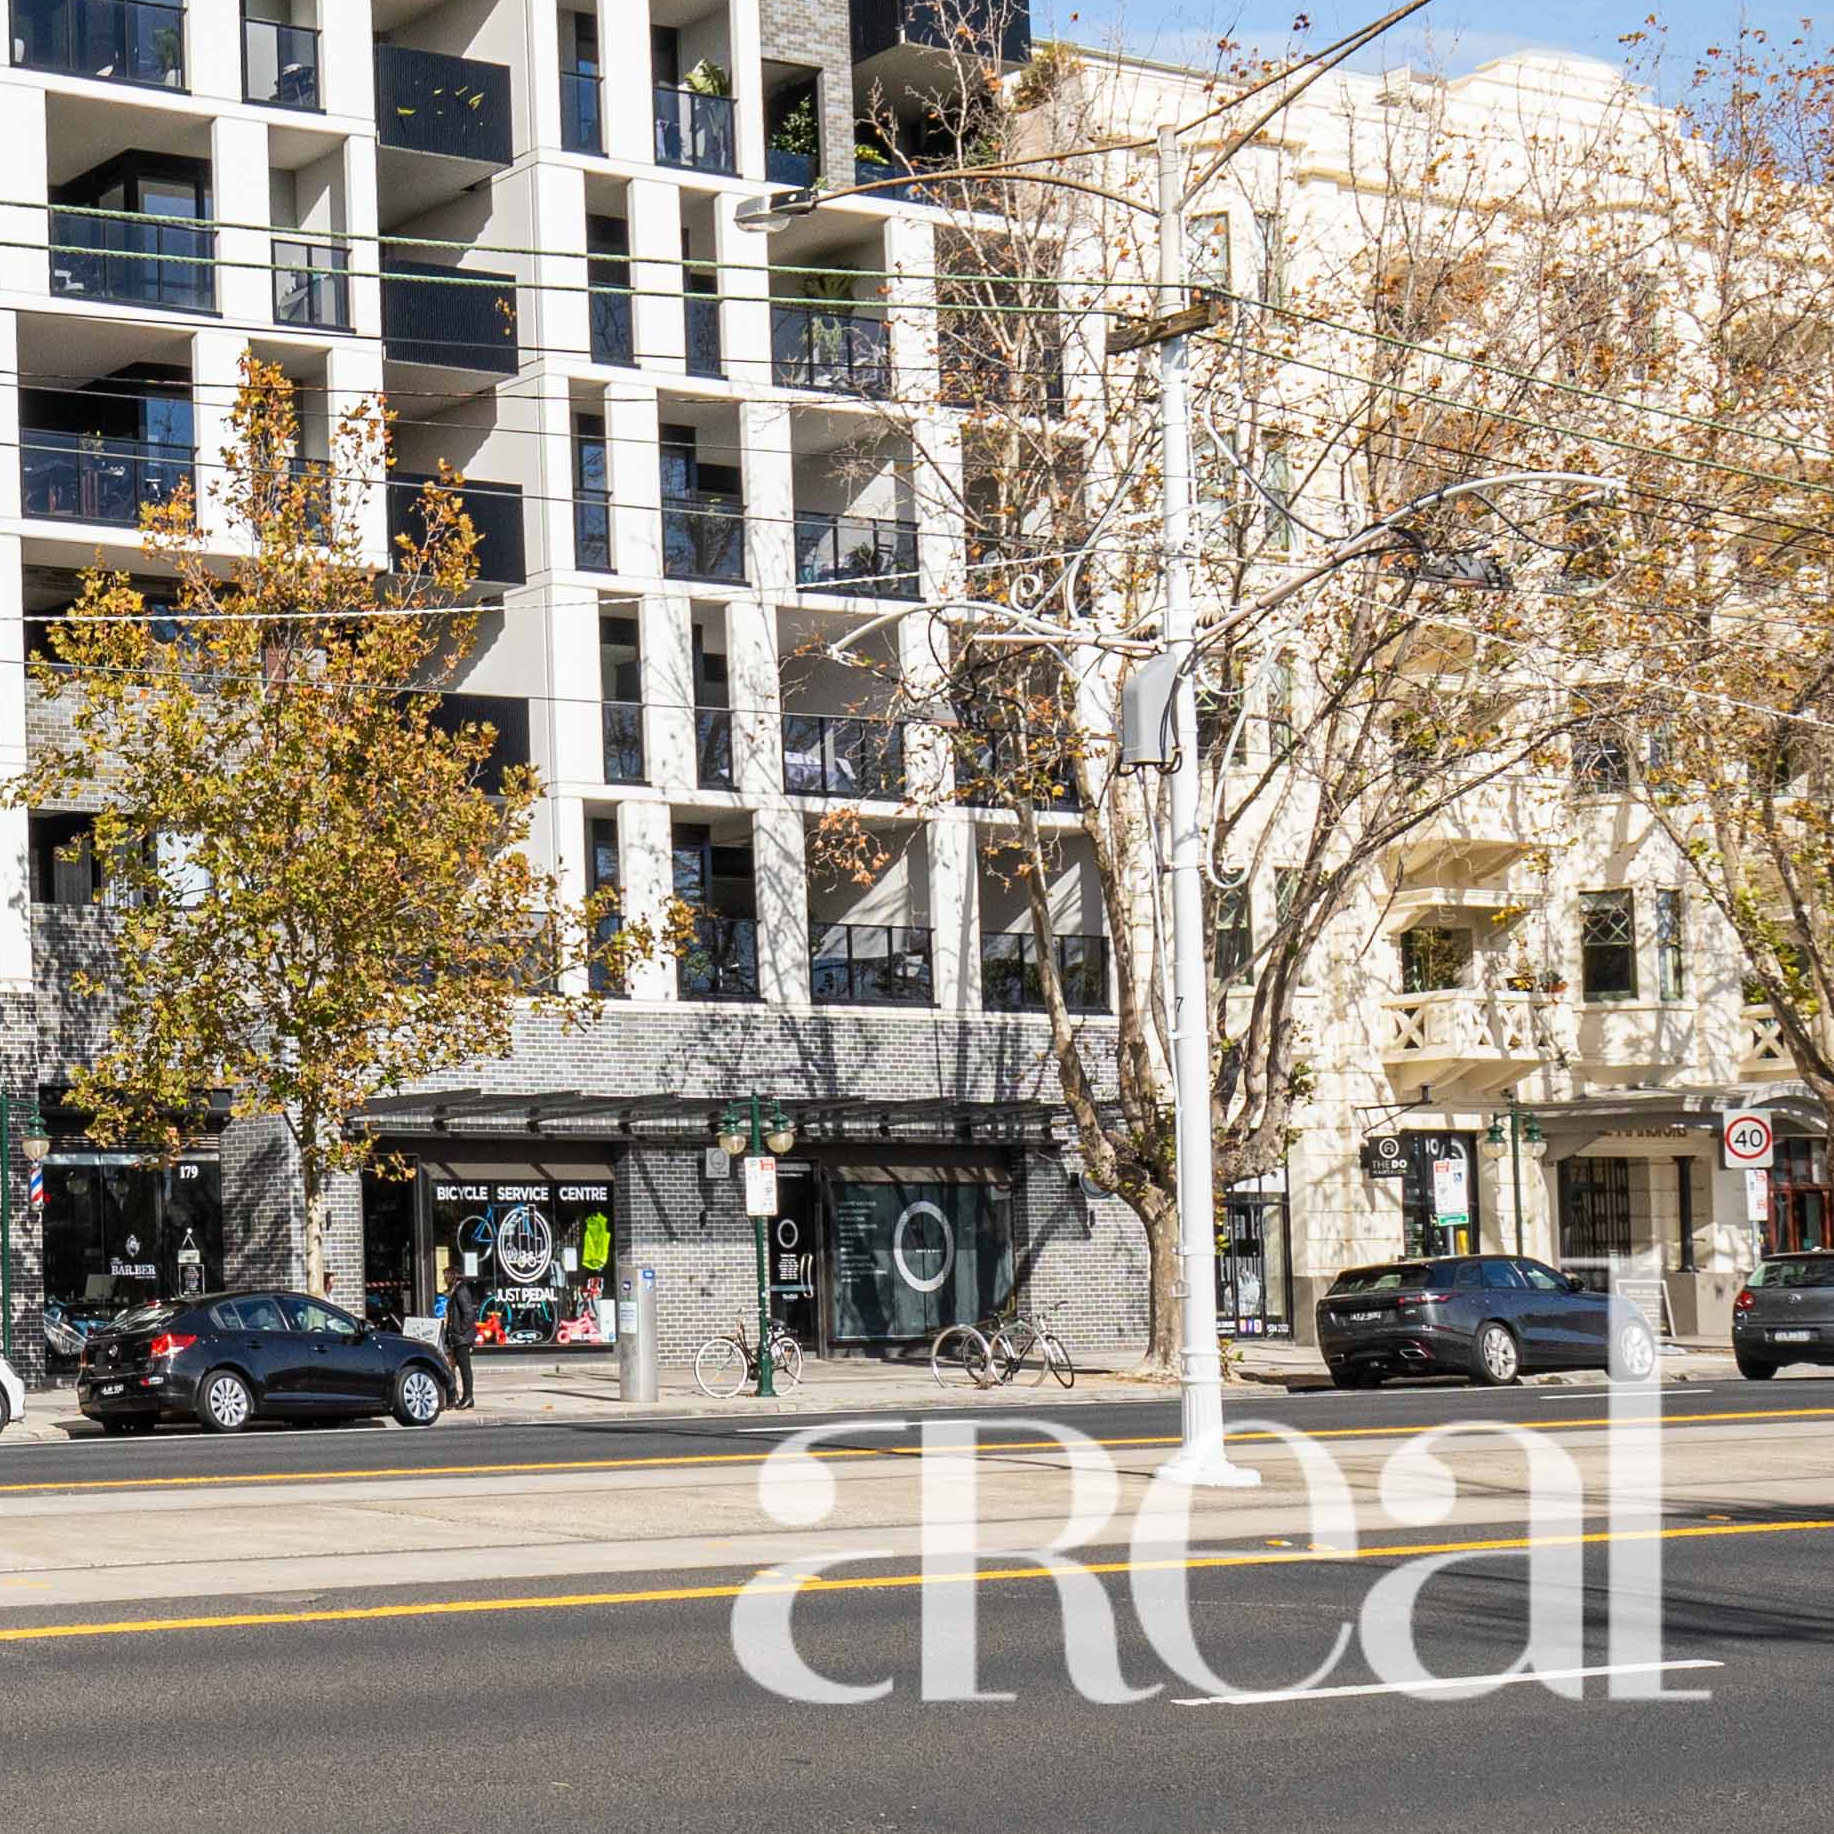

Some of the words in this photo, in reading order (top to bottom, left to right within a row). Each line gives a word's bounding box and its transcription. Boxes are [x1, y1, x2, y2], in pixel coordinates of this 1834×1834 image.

[1734, 1129, 1763, 1148] 40
[180, 1166, 199, 1179] 179
[436, 1186, 488, 1201] BICYCLE
[497, 1186, 549, 1201] SERVICE
[559, 1187, 608, 1201] CENTRE
[495, 1288, 521, 1302] JUST
[521, 1288, 558, 1303] PEDAL
